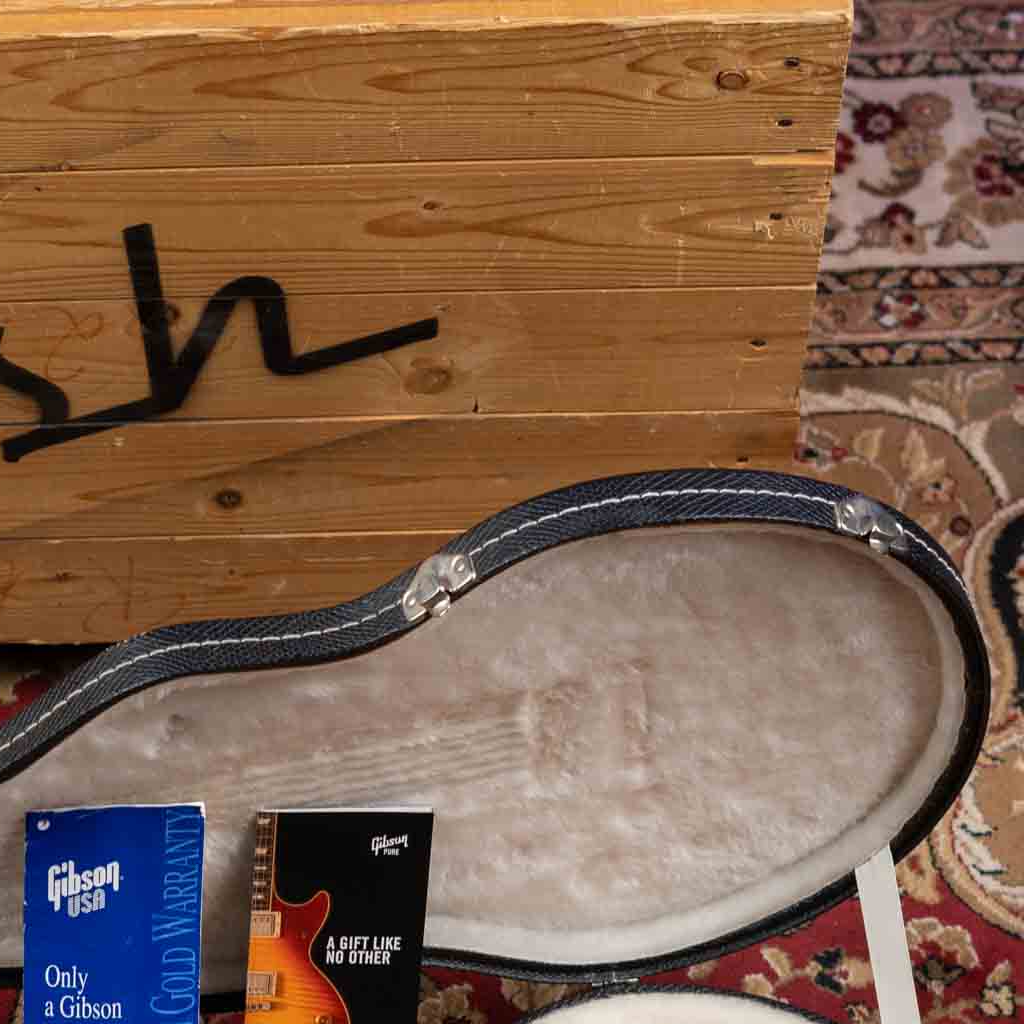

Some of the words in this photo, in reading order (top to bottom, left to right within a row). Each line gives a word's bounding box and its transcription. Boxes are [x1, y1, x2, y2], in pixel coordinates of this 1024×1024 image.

[371, 834, 409, 857] Gibson
[383, 848, 400, 856] PURE
[47, 860, 120, 912] Gibson
[151, 809, 201, 943] WARRANTY
[67, 888, 106, 918] USA
[326, 936, 336, 951] A
[339, 936, 370, 951] GIFT
[373, 936, 402, 951] LIKE
[326, 950, 344, 965] NO
[348, 950, 391, 965] OTHER
[44, 964, 89, 995] Only
[150, 947, 196, 1015] GOLD
[44, 1000, 55, 1017] a
[59, 995, 123, 1020] Gibson
